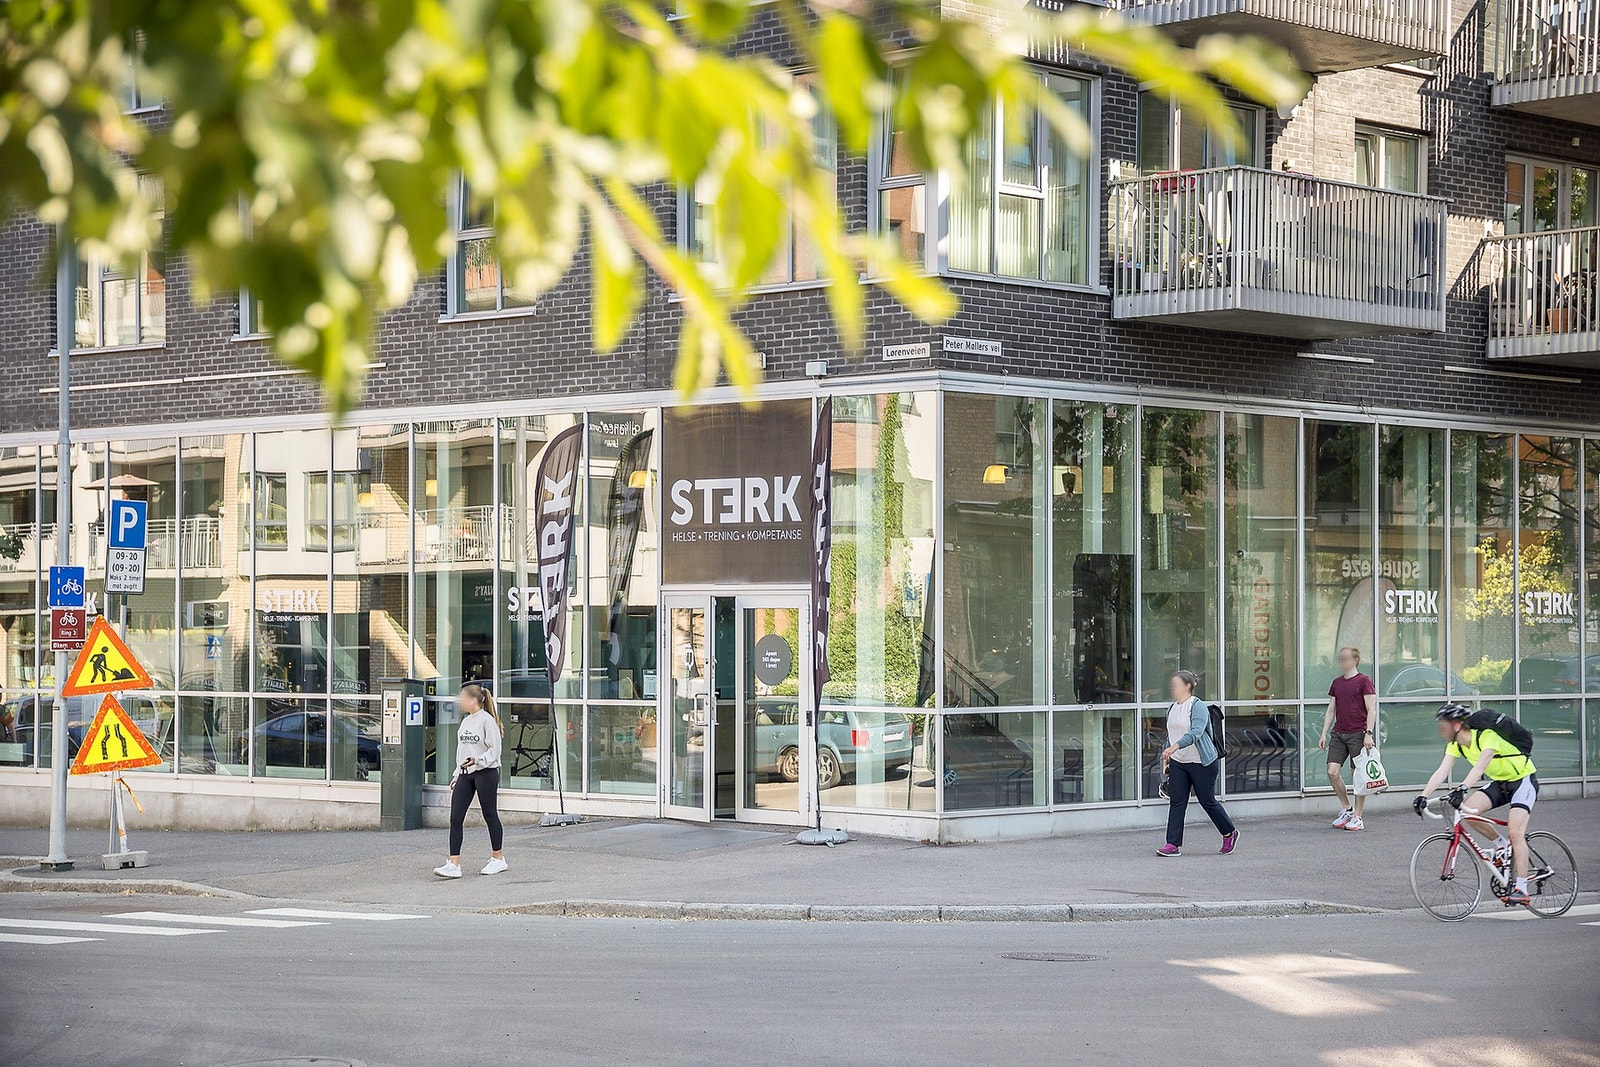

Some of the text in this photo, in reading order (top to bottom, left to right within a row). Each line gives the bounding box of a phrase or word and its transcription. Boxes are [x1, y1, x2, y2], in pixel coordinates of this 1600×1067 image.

[886, 346, 927, 357] Lørenveien
[945, 339, 1000, 353] Peter Møllers vei
[670, 475, 802, 526] STERK
[118, 506, 138, 542] P
[672, 529, 802, 542] HELSE TRENING KOMPETANSE
[109, 573, 122, 581] Maks
[262, 589, 319, 614] STERK
[1384, 589, 1438, 614] STERK
[1525, 591, 1574, 615] STERK
[410, 701, 421, 720] P
